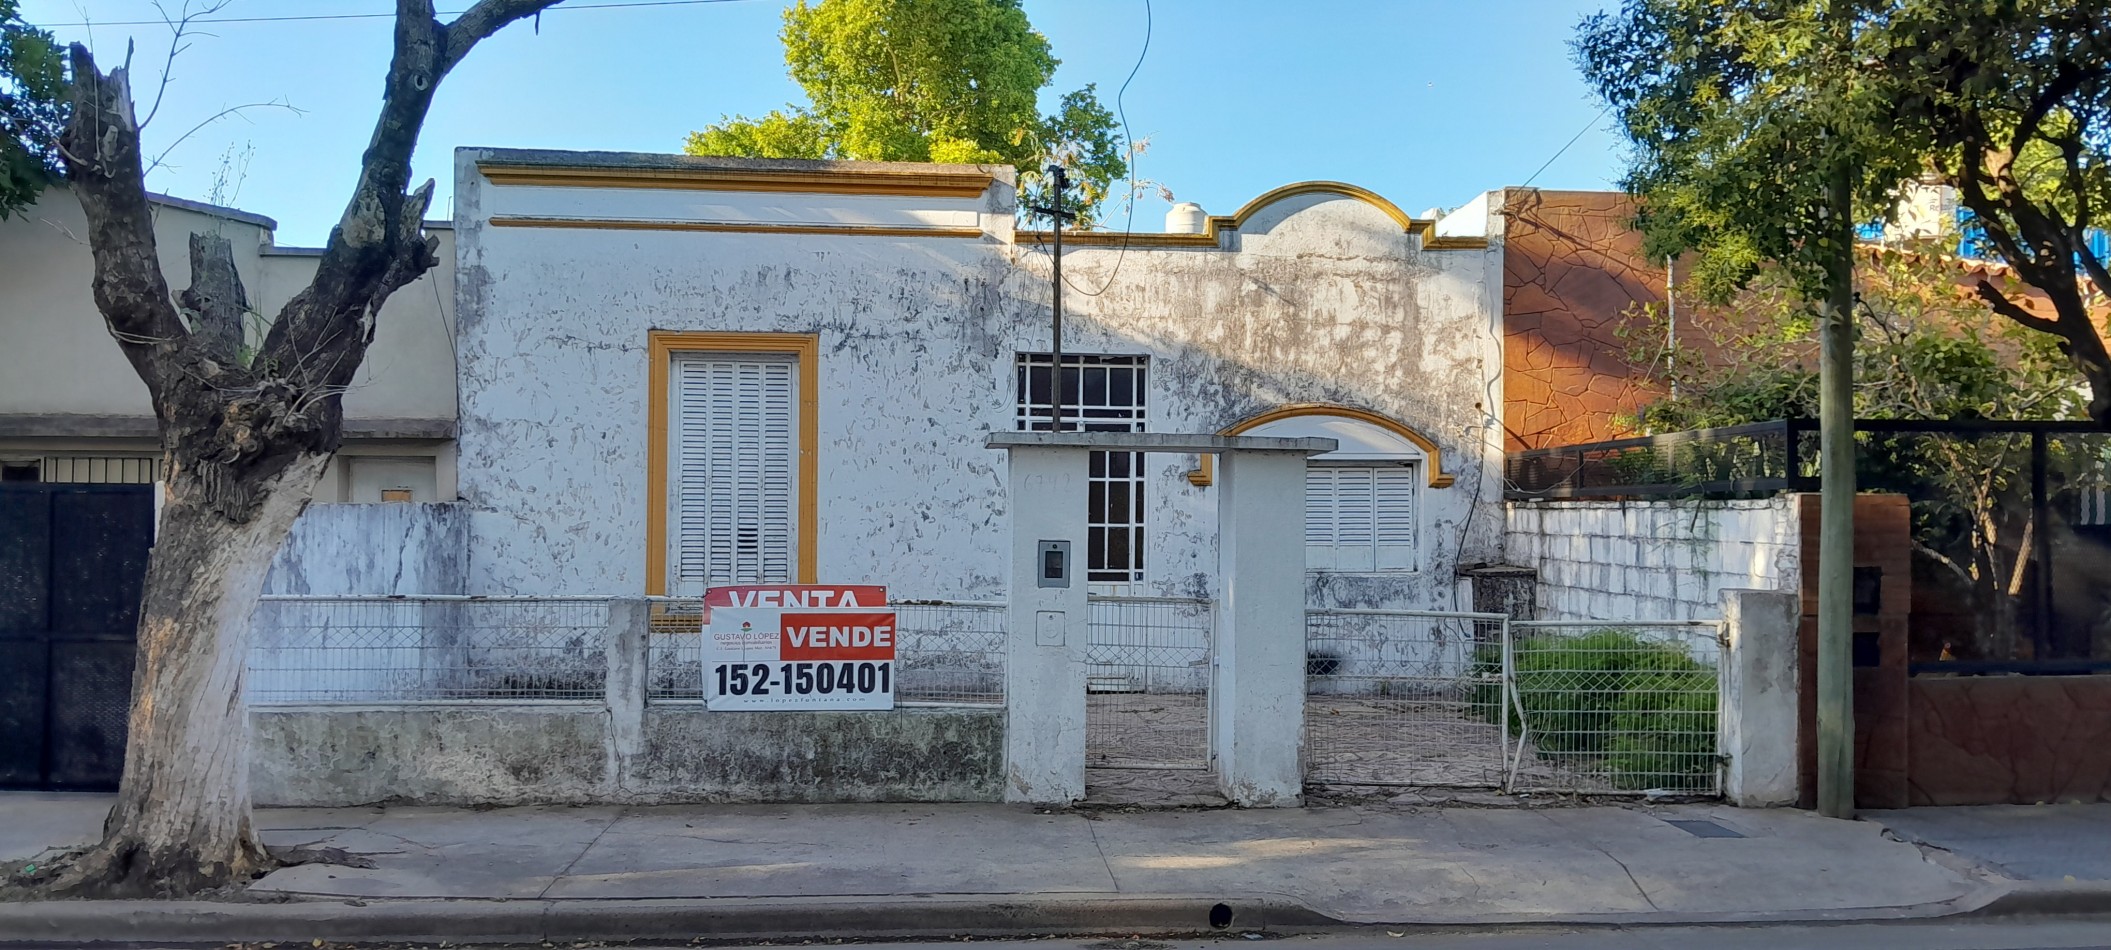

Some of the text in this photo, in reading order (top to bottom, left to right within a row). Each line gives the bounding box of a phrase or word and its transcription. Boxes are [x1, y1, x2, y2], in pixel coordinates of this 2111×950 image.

[729, 590, 859, 608] VENTA
[713, 631, 780, 641] GUSTAVO LÓPEZ
[786, 626, 892, 648] VENDE
[715, 662, 891, 696] 152-150401
